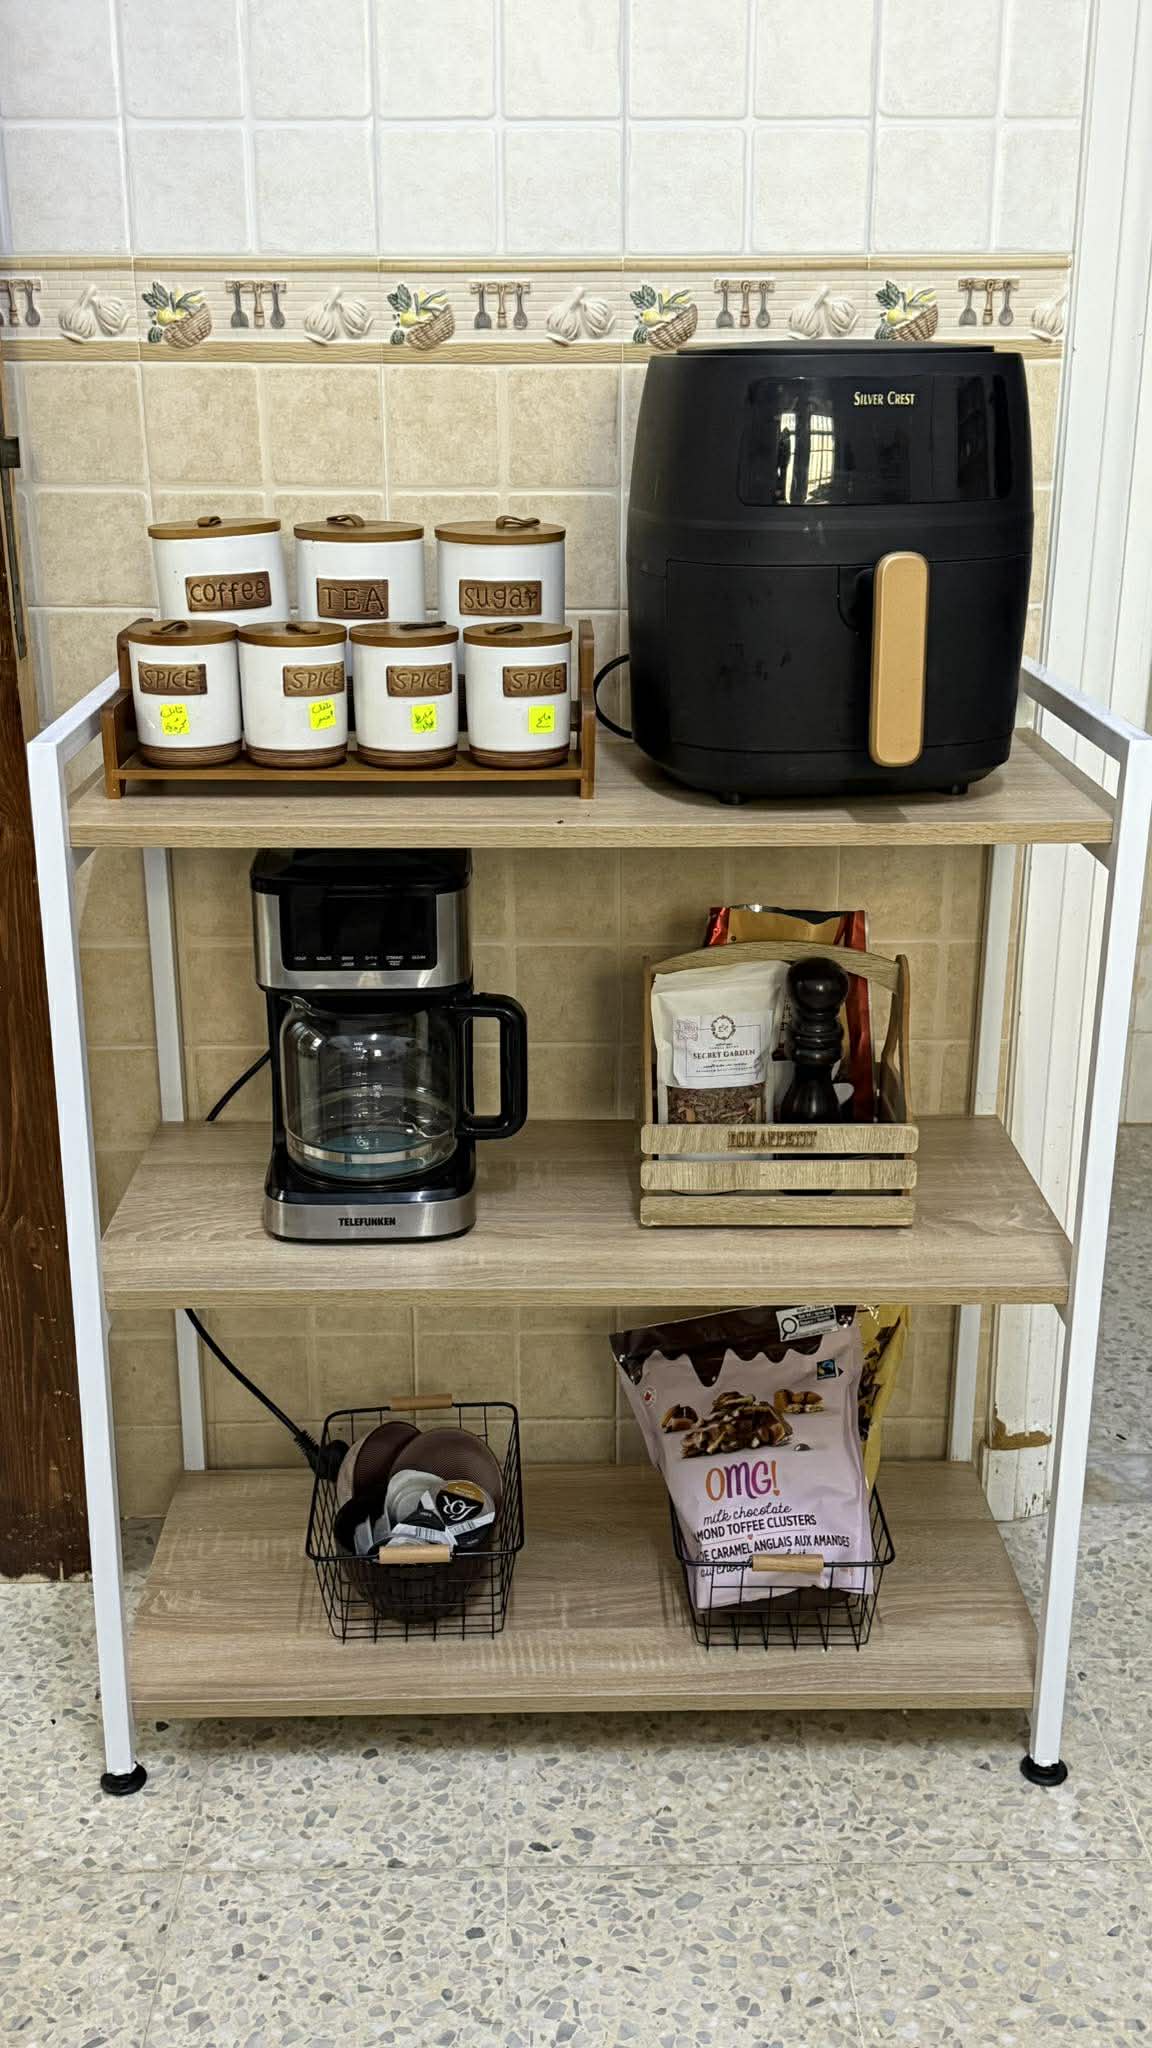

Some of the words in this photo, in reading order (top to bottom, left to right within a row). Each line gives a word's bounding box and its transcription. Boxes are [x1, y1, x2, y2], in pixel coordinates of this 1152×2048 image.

[854, 391, 884, 406] SILVER
[887, 391, 916, 405] CREST
[190, 581, 267, 609] coffee
[321, 586, 385, 612] TEA
[464, 585, 538, 609] sugar
[143, 669, 196, 689] SPICE
[292, 668, 341, 689] SPICE
[394, 669, 448, 690] SPICE
[512, 669, 561, 690] SPICE
[692, 1051, 722, 1060] SECRET
[723, 1048, 756, 1058] GARDEN
[337, 1217, 396, 1227] TELEFUNKEN
[705, 1460, 780, 1501] OMG!
[703, 1509, 732, 1526] milk
[733, 1502, 793, 1520] chocolate
[727, 1518, 766, 1536] TOFFEE
[767, 1514, 817, 1529] CLUSTERS
[711, 1543, 753, 1560] CARAMEL
[753, 1535, 793, 1553] ANGLAIS
[794, 1535, 812, 1547] AUX
[812, 1535, 850, 1548] AMANDES
